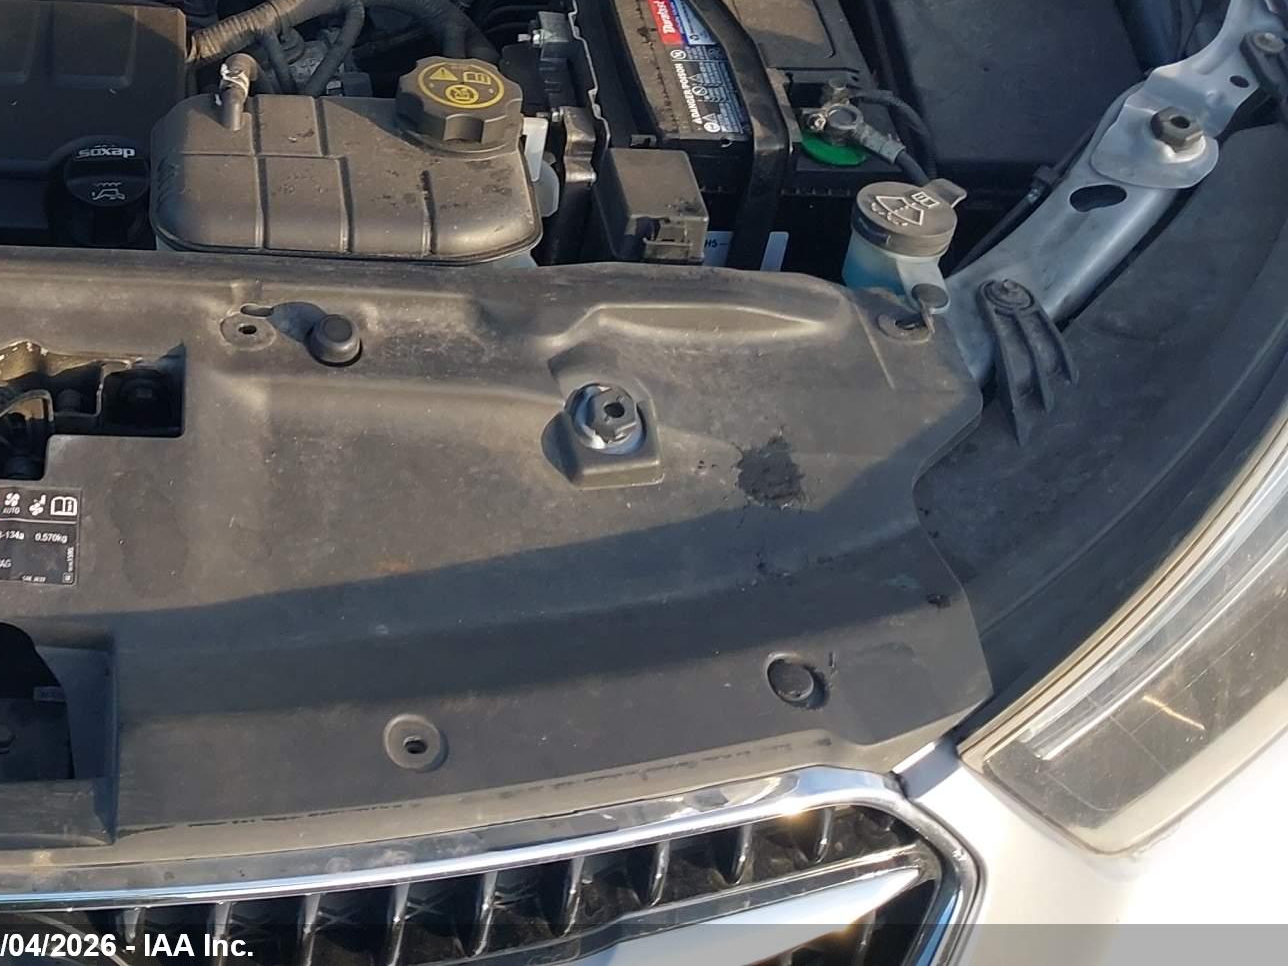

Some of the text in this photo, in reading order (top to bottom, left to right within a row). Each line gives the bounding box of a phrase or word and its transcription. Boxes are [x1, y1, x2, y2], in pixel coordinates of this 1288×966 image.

[674, 63, 700, 119] DANGER POISON
[35, 532, 68, 543] 0.570kg
